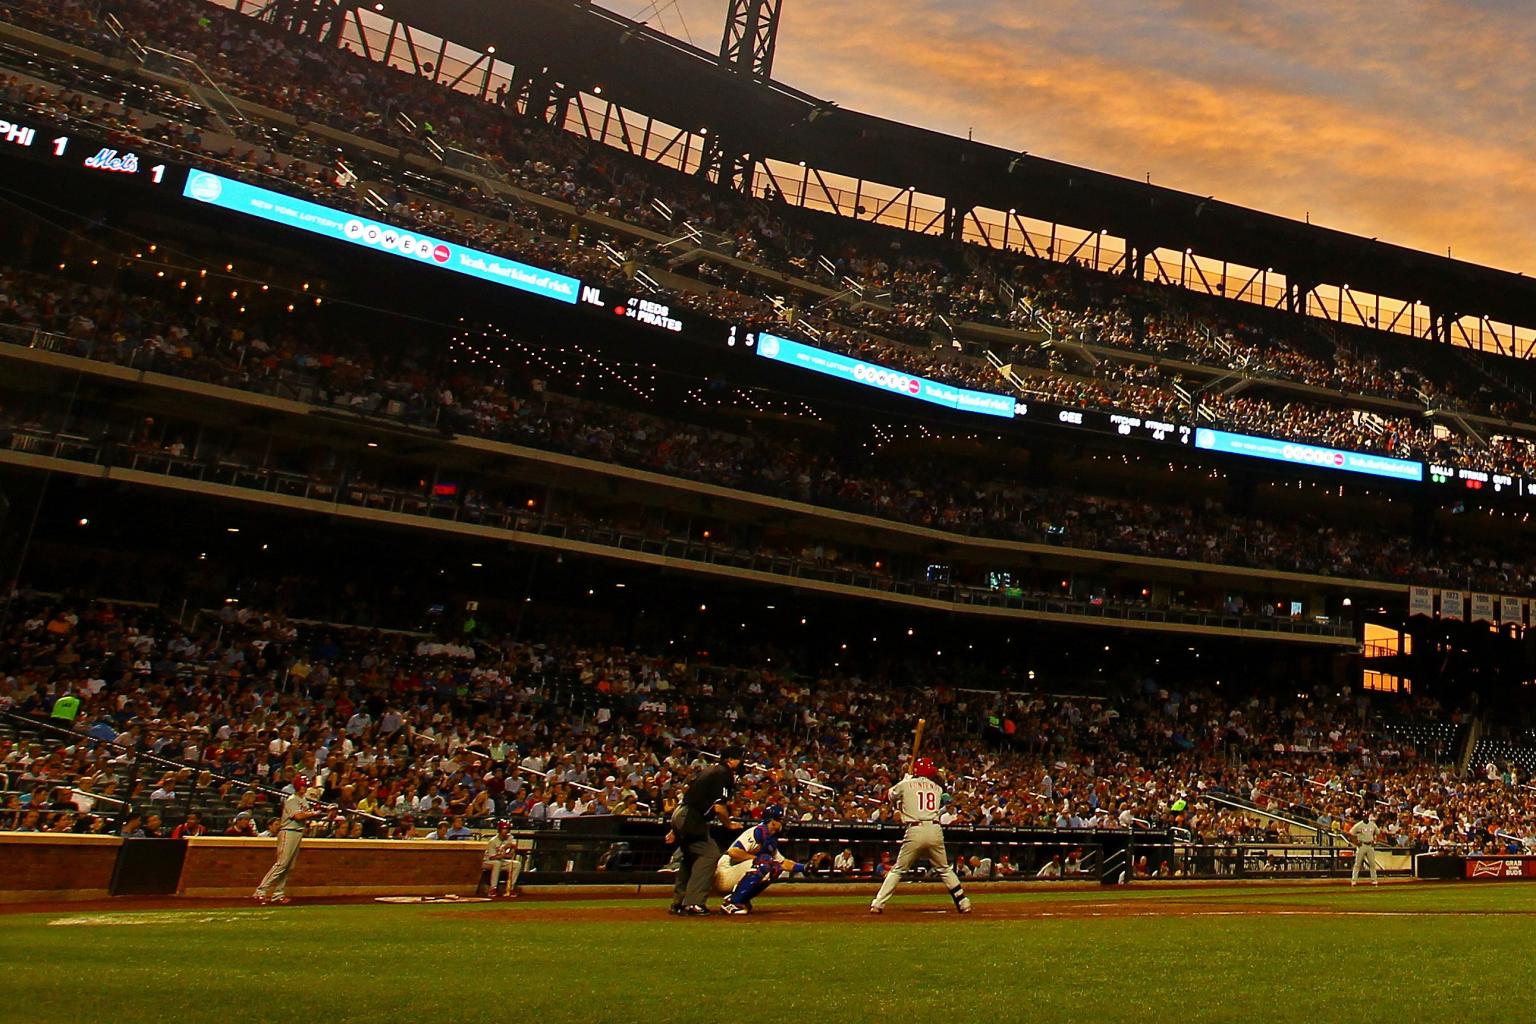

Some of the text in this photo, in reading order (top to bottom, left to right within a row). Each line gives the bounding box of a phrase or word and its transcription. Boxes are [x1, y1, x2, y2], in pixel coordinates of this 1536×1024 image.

[52, 136, 68, 156] 1
[83, 147, 140, 173] Mets
[151, 164, 165, 184] 1
[347, 221, 432, 256] POWER
[581, 285, 605, 307] NL
[639, 299, 669, 317] REDS
[625, 308, 683, 333] 34 PIRATES
[1058, 411, 1083, 425] GEE
[917, 791, 936, 811] 18
